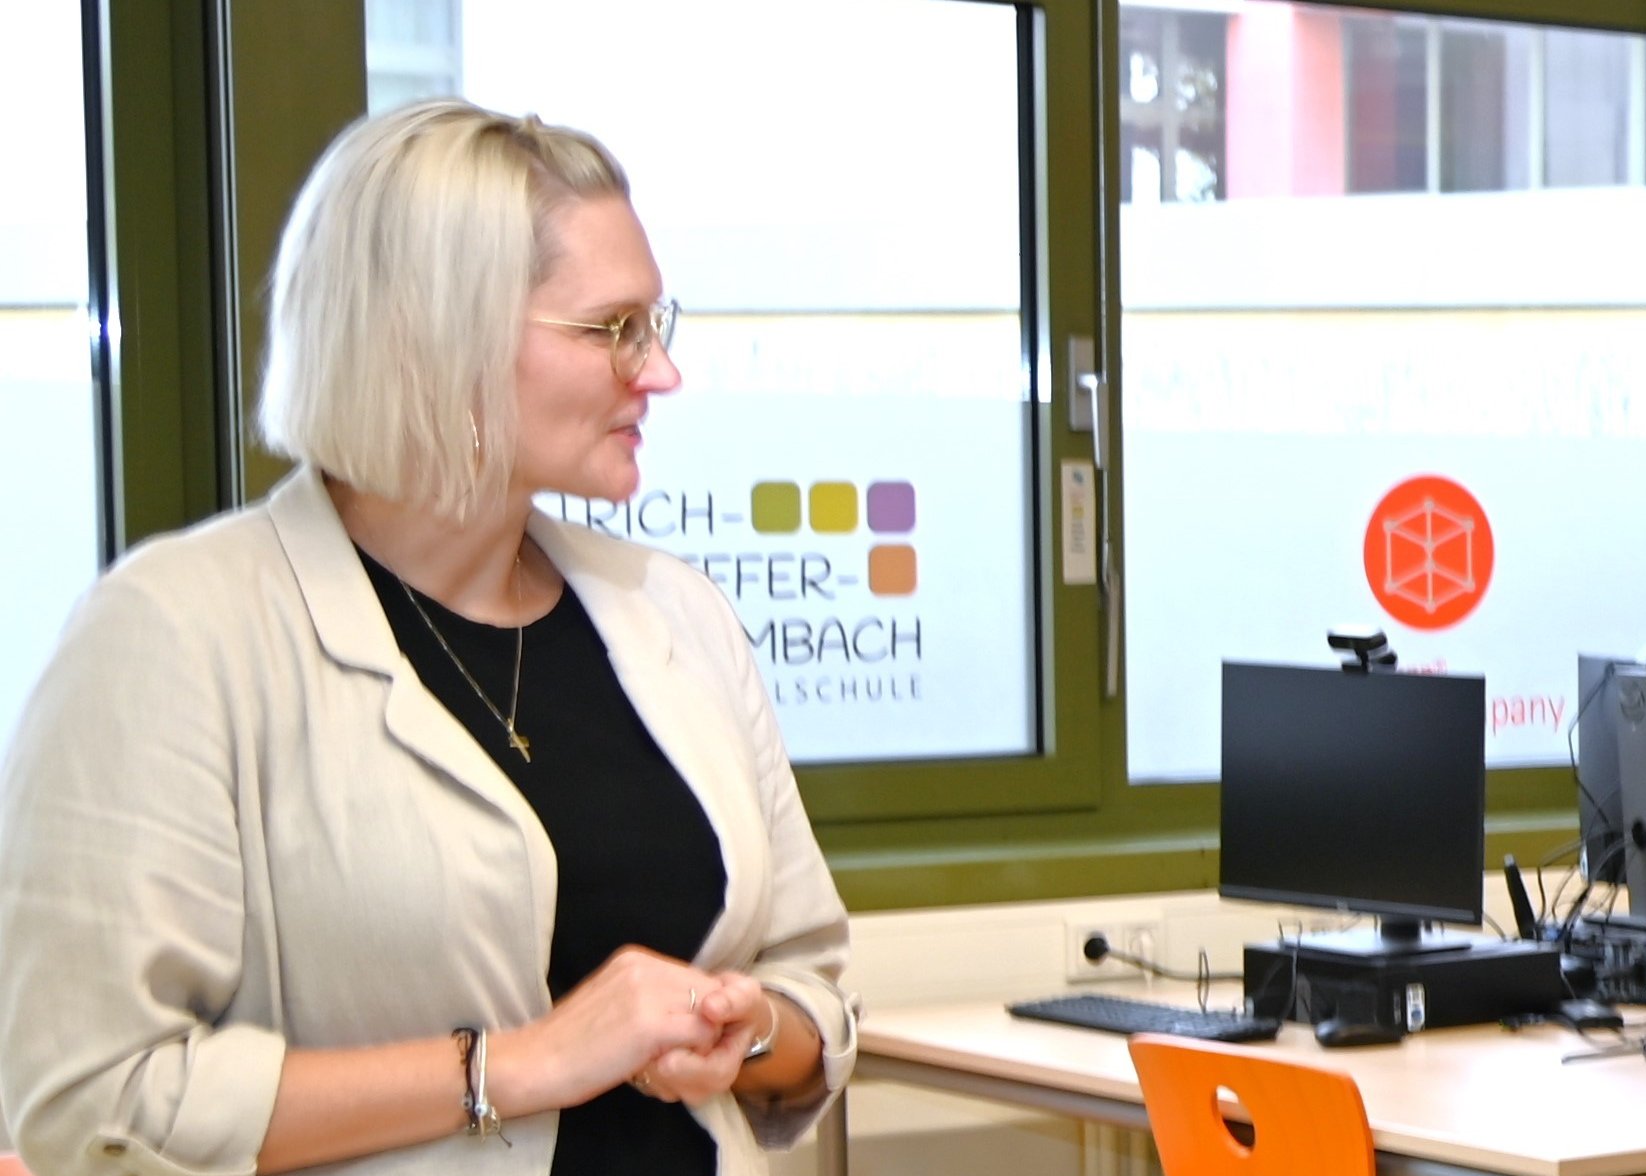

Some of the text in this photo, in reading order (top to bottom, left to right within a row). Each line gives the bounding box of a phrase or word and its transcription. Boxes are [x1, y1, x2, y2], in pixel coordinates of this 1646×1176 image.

[743, 615, 922, 664] MBACH
[775, 677, 922, 704] LSCHULE
[1492, 694, 1567, 737] pany
